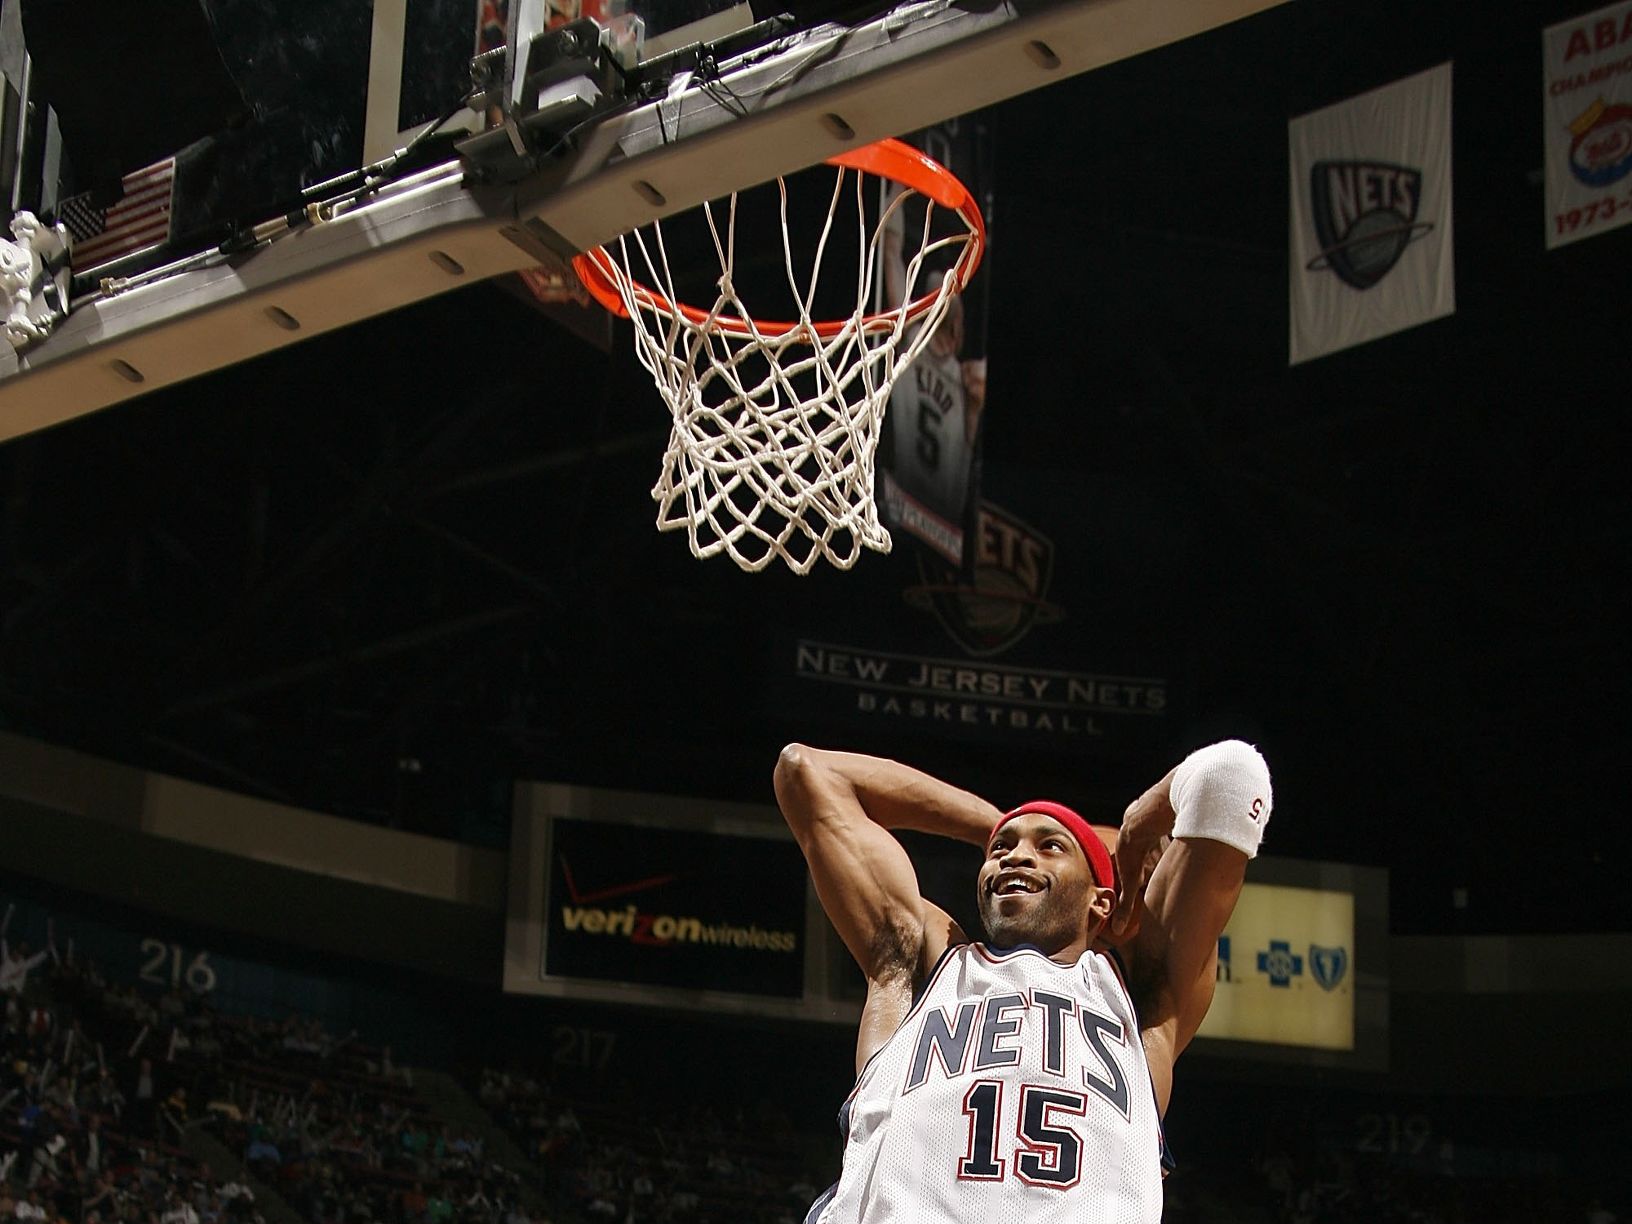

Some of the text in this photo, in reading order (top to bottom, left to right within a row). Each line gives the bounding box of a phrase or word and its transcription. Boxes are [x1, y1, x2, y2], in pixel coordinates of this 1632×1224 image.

[1326, 164, 1416, 242] NETS
[798, 646, 1167, 711] NEW JERSEY NETS
[858, 692, 1104, 735] BASKETBALL
[138, 936, 217, 993] 216
[902, 986, 1131, 1123] NETS
[957, 1079, 1088, 1191] 15
